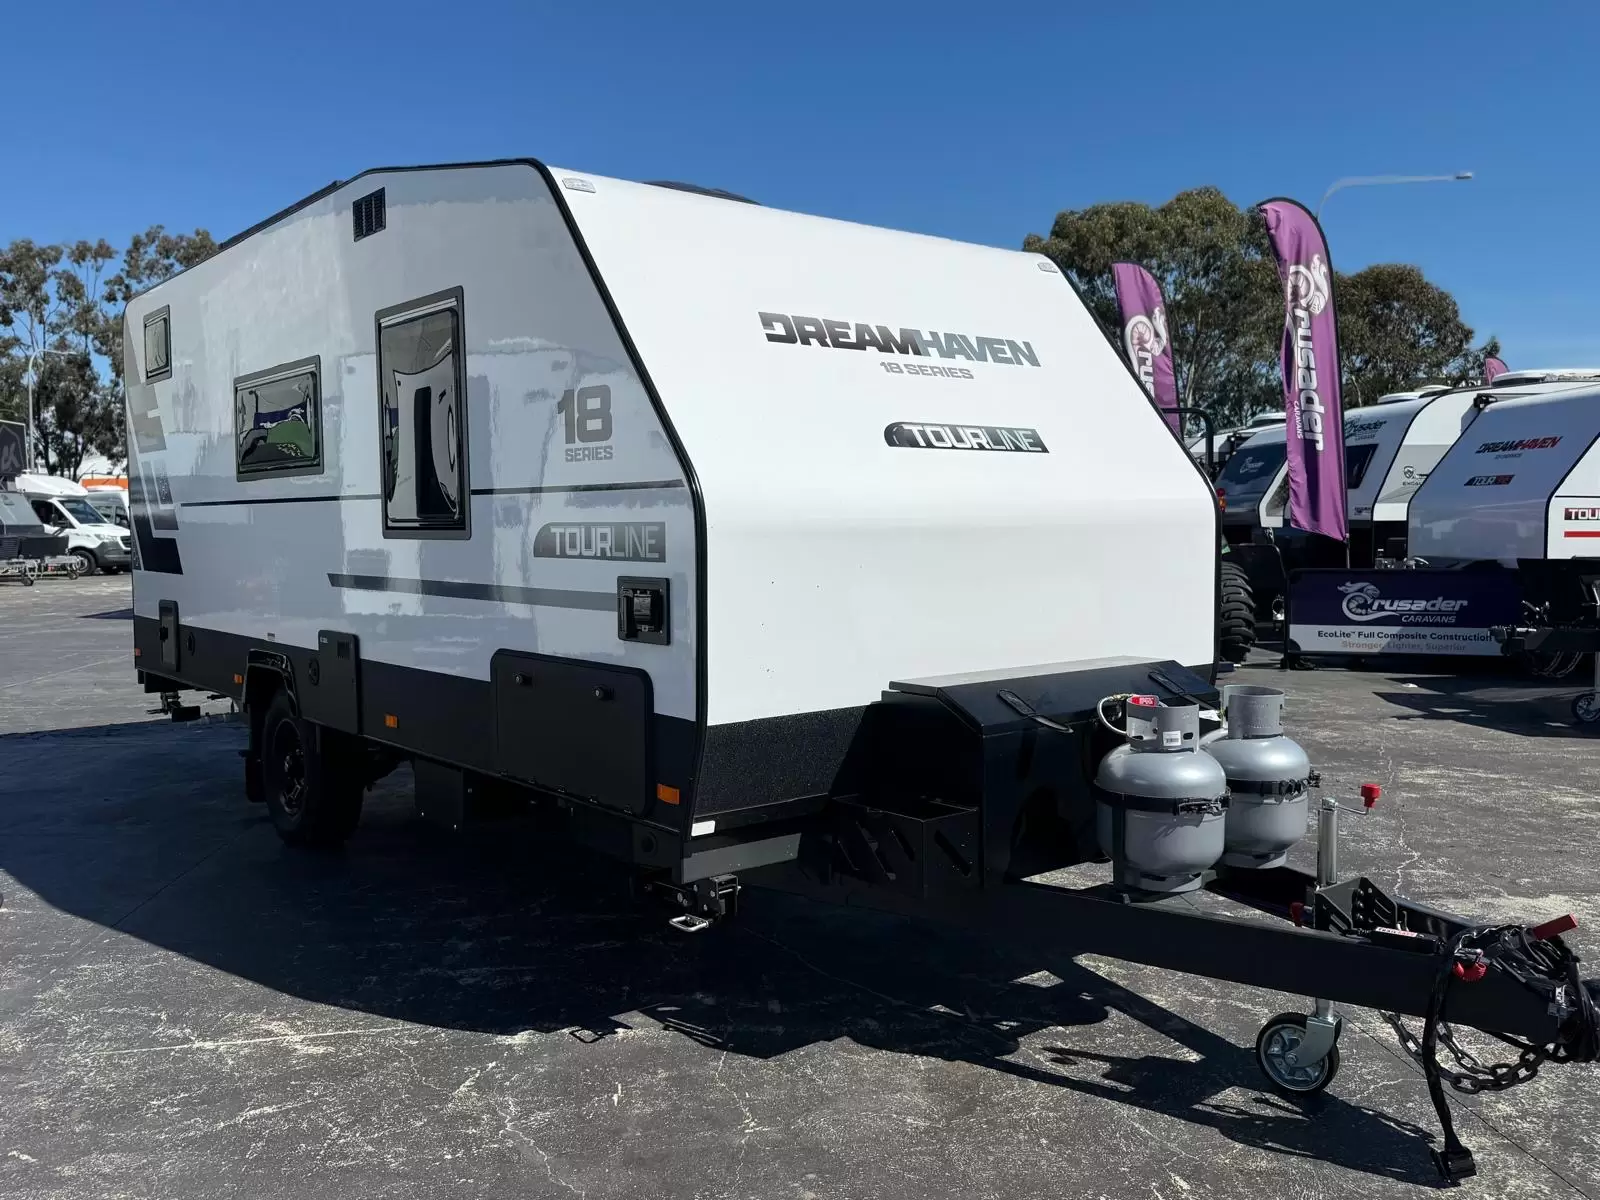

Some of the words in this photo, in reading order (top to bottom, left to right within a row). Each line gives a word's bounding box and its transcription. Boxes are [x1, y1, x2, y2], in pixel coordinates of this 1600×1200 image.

[758, 311, 1041, 367] DREAMHAVEN
[880, 361, 904, 374] 18
[907, 363, 974, 379] SERIES
[1287, 264, 1325, 451] Crusader
[557, 384, 613, 444] 18
[1293, 400, 1304, 440] CARAVANS
[901, 423, 1042, 451] TOURLINE
[564, 445, 613, 462] SERIES
[1568, 508, 1600, 520] TOU
[550, 525, 660, 559] TOURLINE
[1341, 592, 1468, 622] Crusader
[1401, 615, 1456, 623] CARAVANS
[1357, 631, 1375, 639] Full
[1377, 632, 1428, 641] Composite
[1430, 632, 1493, 642] Construction
